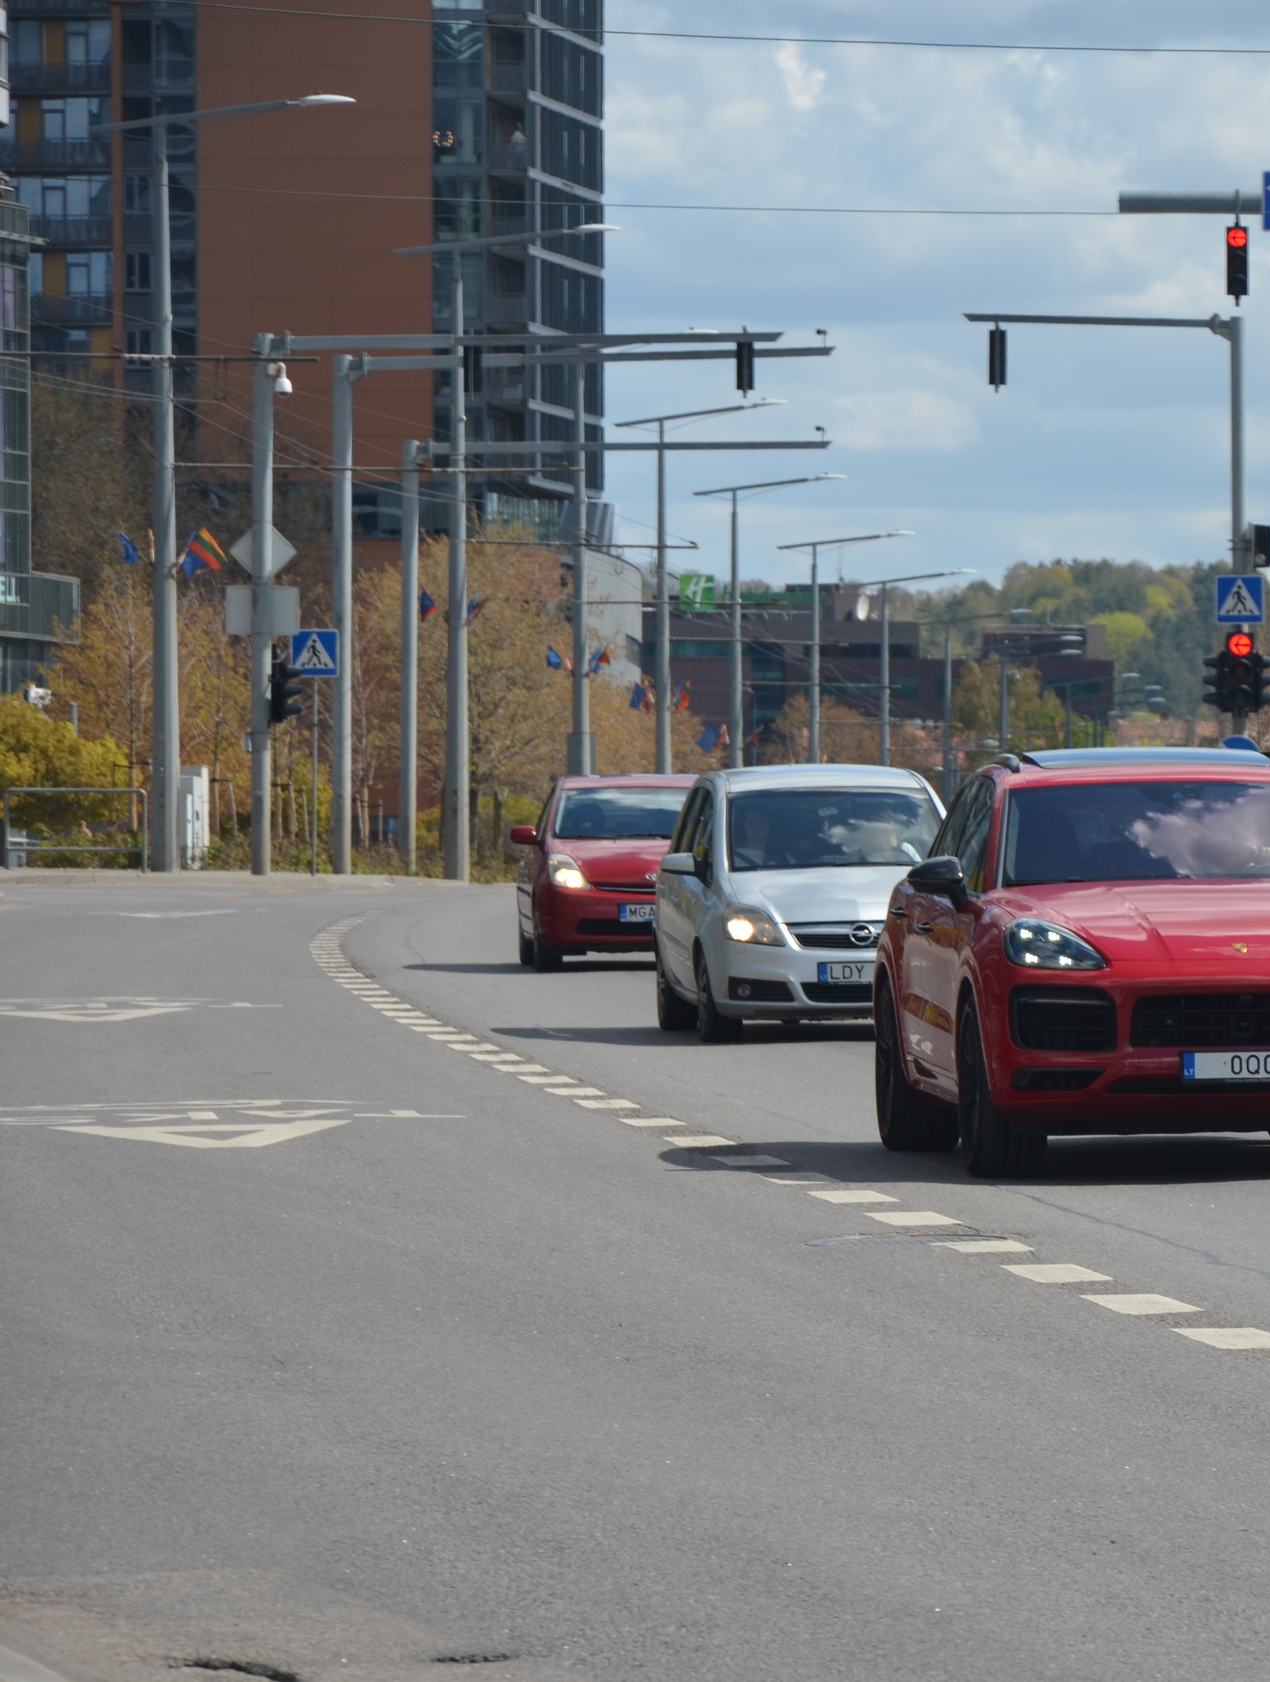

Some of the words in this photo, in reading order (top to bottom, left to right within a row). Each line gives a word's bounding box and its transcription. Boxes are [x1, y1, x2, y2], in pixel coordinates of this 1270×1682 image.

[629, 906, 655, 918] MGA
[829, 965, 865, 980] LDY
[1184, 1068, 1195, 1076] LT
